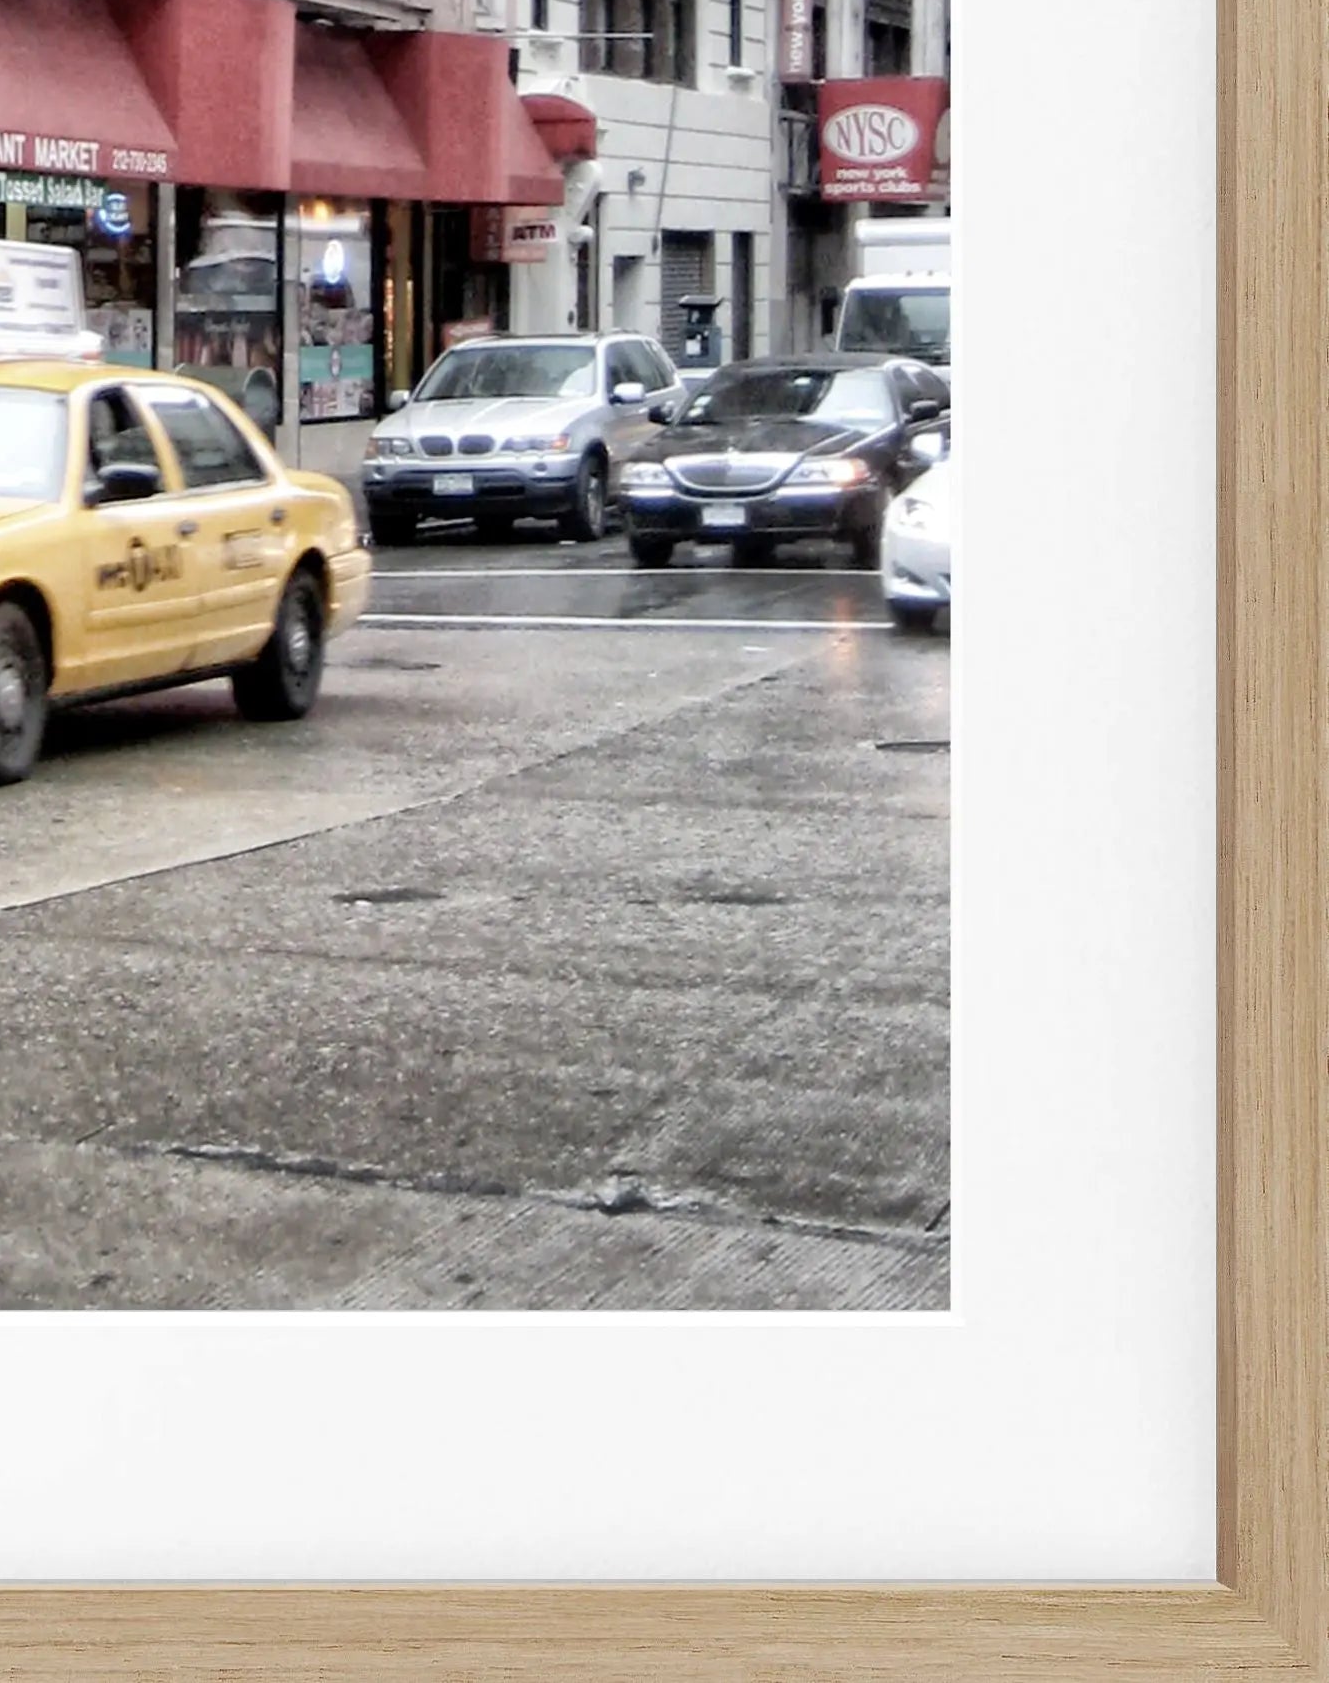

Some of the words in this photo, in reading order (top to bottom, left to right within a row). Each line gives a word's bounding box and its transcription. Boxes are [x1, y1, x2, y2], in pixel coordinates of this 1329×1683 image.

[835, 110, 906, 156] NYSC
[34, 136, 101, 173] MARKET
[835, 168, 871, 180] new
[872, 166, 908, 182] york
[46, 177, 85, 205] Salad
[84, 179, 106, 209] Bar
[824, 182, 876, 196] sports
[877, 180, 922, 194] clubs
[511, 223, 557, 243] ATM
